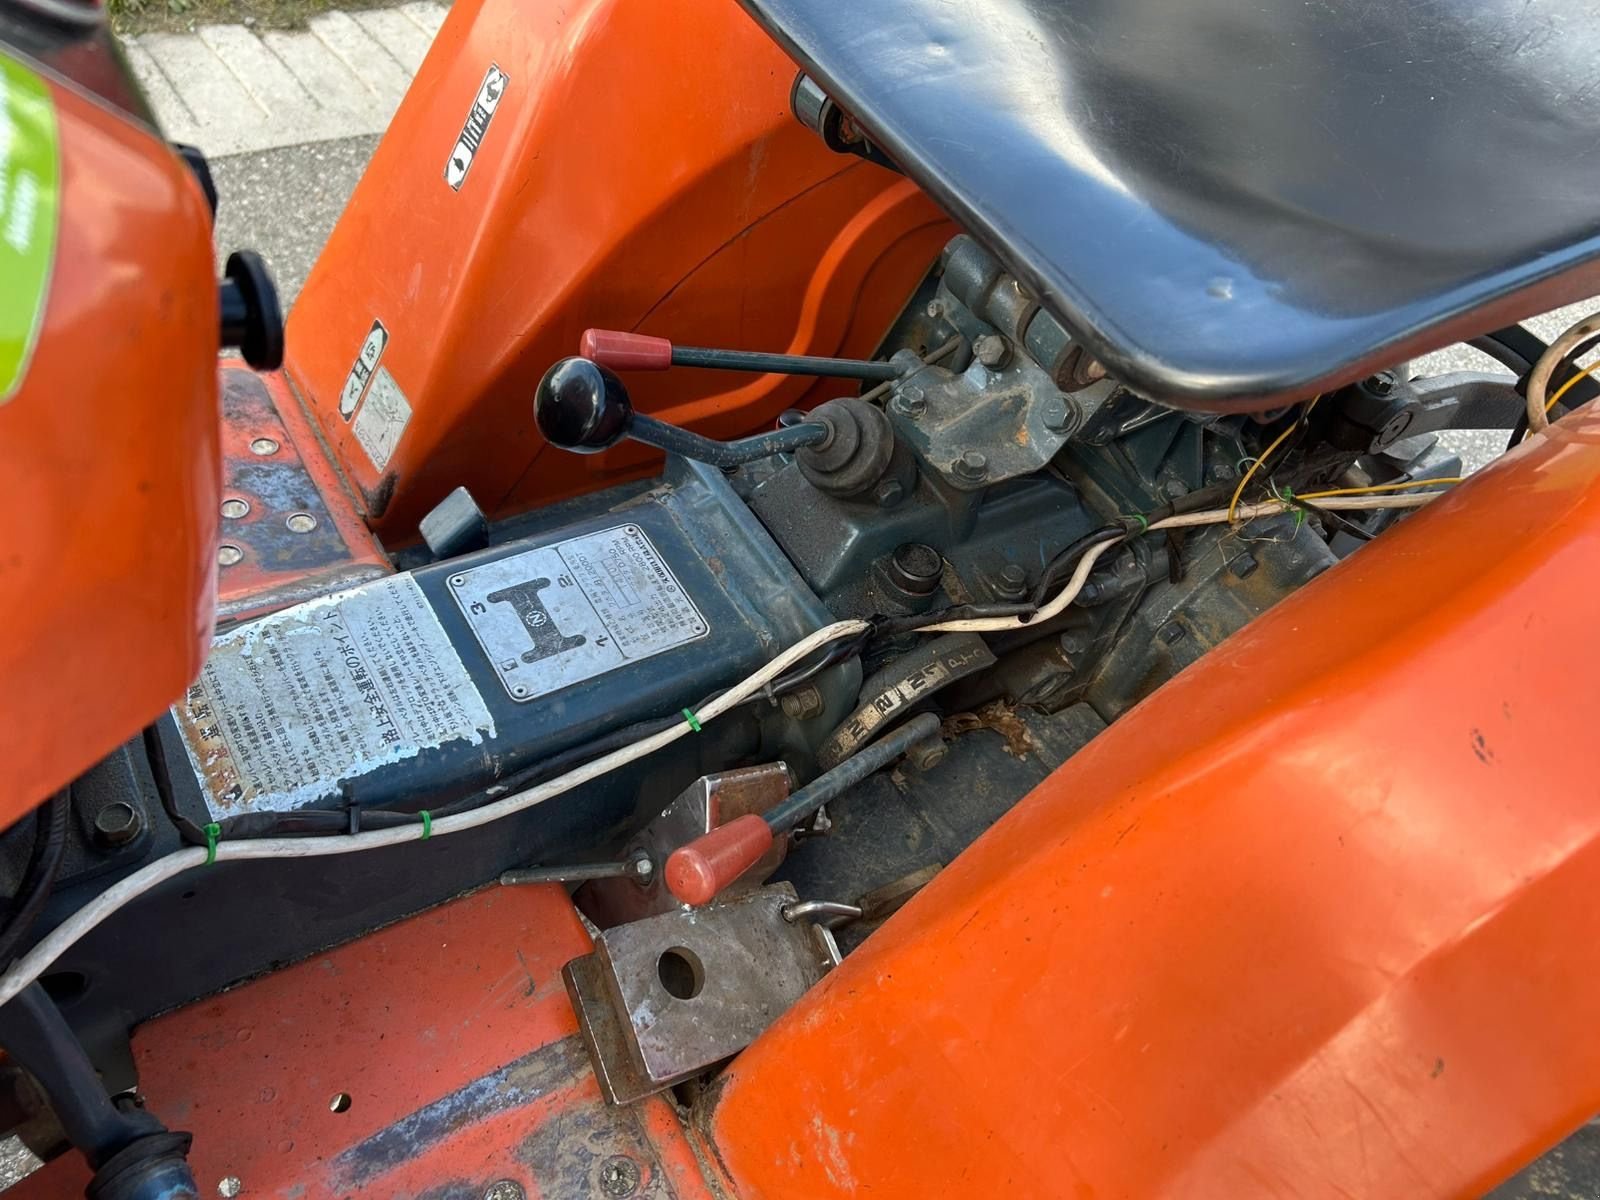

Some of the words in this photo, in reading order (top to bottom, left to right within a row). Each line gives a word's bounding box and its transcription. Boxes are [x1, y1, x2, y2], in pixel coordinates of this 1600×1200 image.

[630, 551, 651, 572] 2800
[319, 608, 402, 745] 路上安全運転のポイント
